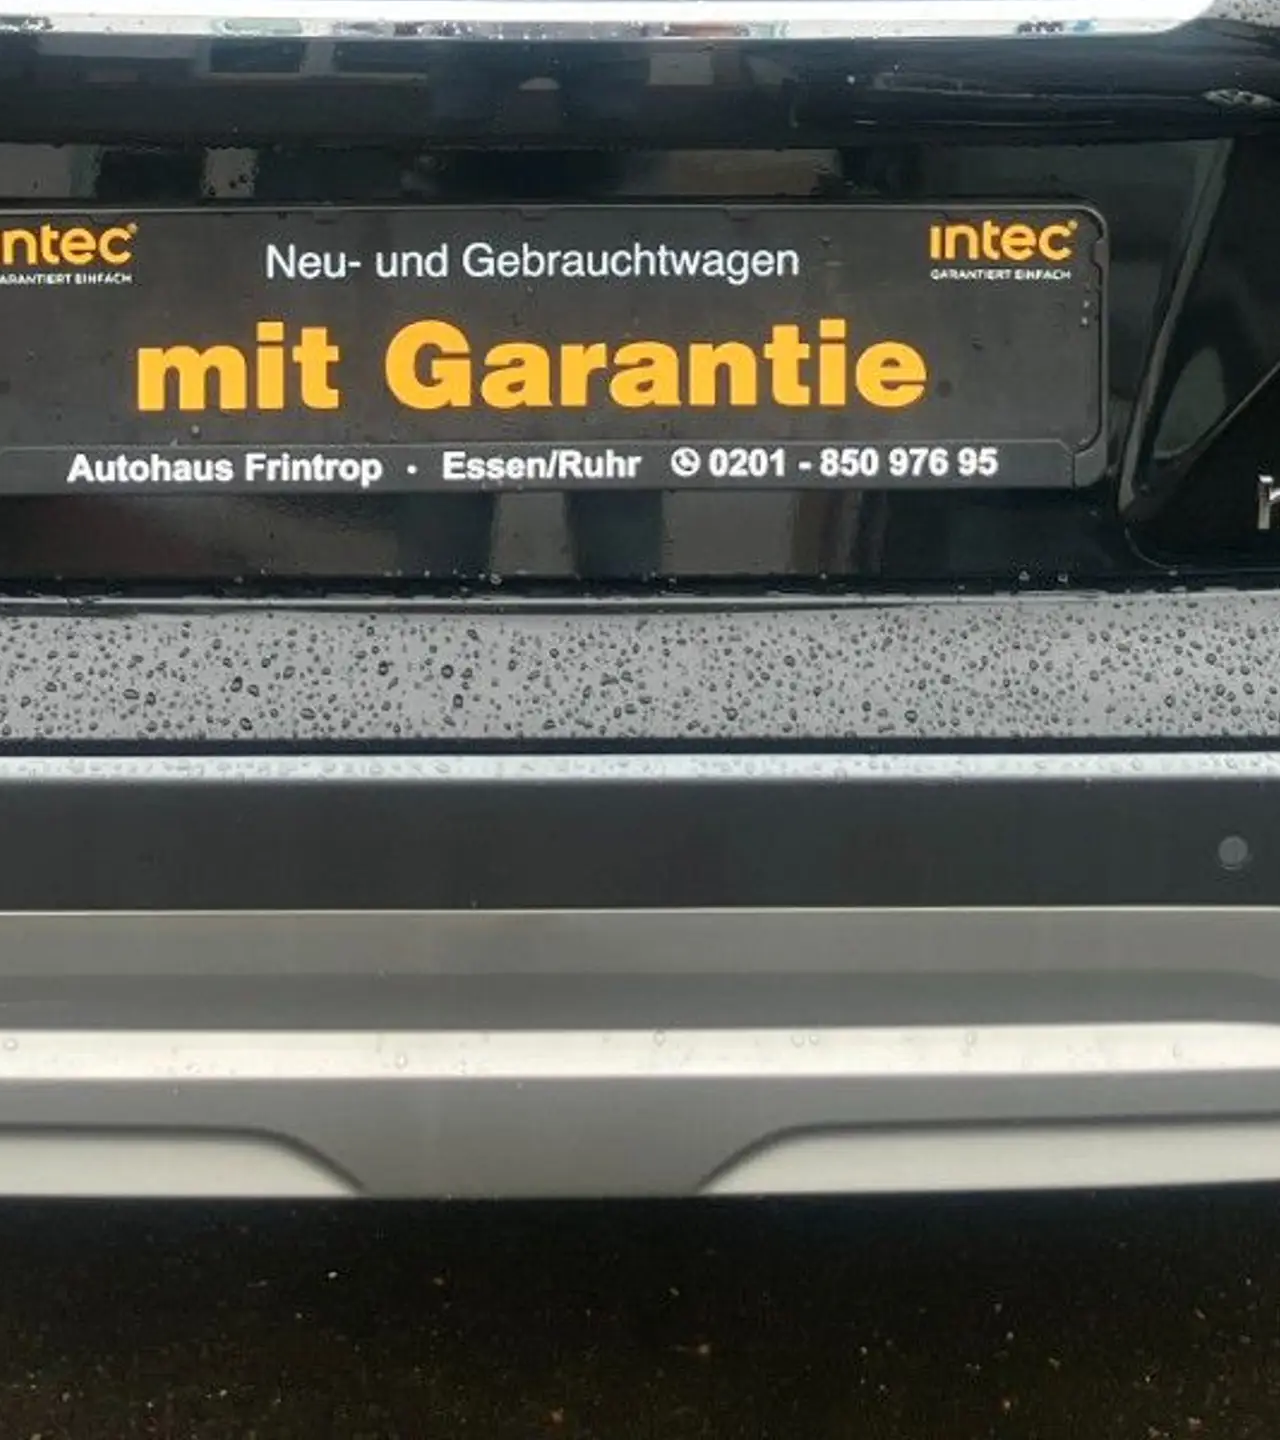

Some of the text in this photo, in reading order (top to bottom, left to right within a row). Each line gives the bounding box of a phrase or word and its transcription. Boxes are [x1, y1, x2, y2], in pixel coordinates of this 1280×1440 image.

[930, 219, 1078, 260] intec
[74, 272, 133, 285] EINFACH
[266, 241, 800, 286] Neu- und Gebrauchtwagen
[929, 268, 1072, 281] GARANTIERT EINFACH
[137, 318, 927, 411] mit Garantie
[66, 453, 235, 483] Autohaus
[245, 452, 384, 488] Frintrop
[442, 449, 643, 483] Essen/Ruhr
[708, 447, 786, 478] 0201
[819, 447, 880, 478] 850
[888, 446, 950, 477] 976
[957, 446, 999, 477] 95
